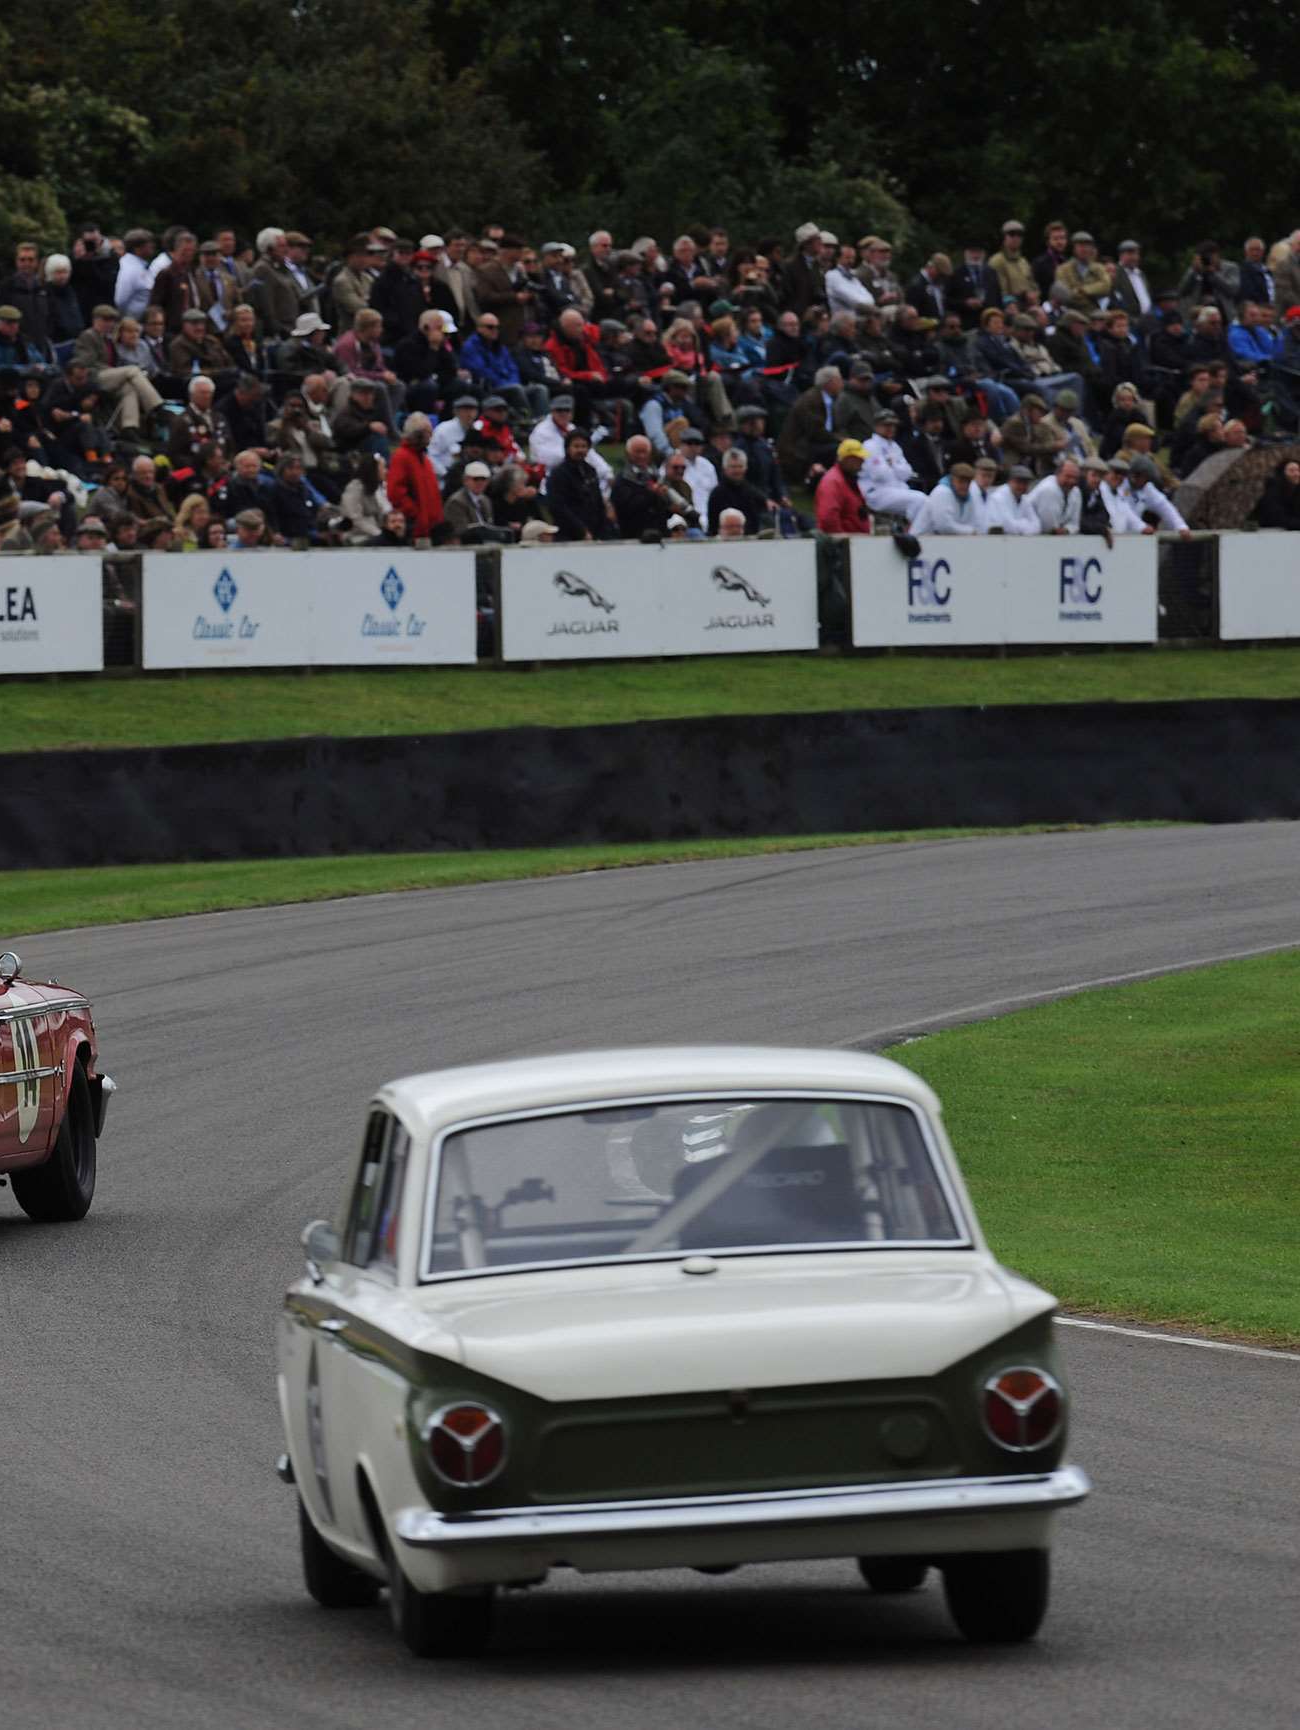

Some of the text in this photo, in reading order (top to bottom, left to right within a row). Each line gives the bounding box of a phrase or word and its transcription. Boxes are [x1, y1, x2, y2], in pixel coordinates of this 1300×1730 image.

[907, 557, 951, 606] F&C
[1059, 556, 1102, 605] F&C
[547, 619, 619, 636] JAGUAR
[703, 613, 774, 630] JAGUAR
